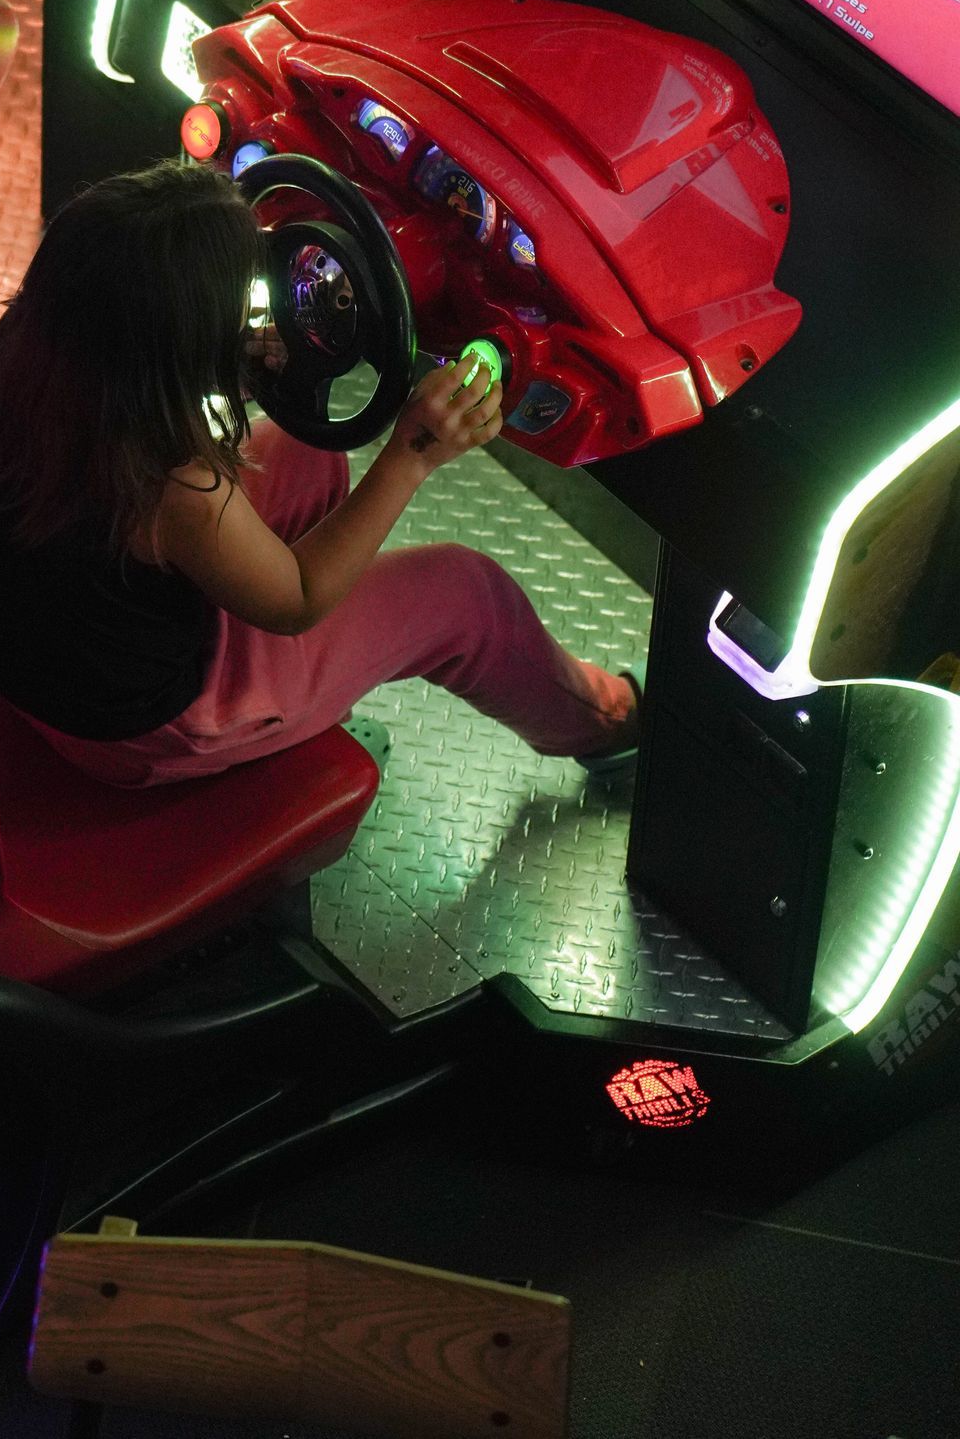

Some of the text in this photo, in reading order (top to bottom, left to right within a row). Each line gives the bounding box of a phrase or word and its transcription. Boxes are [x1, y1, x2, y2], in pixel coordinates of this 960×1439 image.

[834, 6, 874, 40] Swipe
[383, 122, 402, 144] 7294
[457, 176, 475, 194] 216
[606, 1066, 699, 1108] RAW
[620, 1090, 711, 1120] THRILLS
